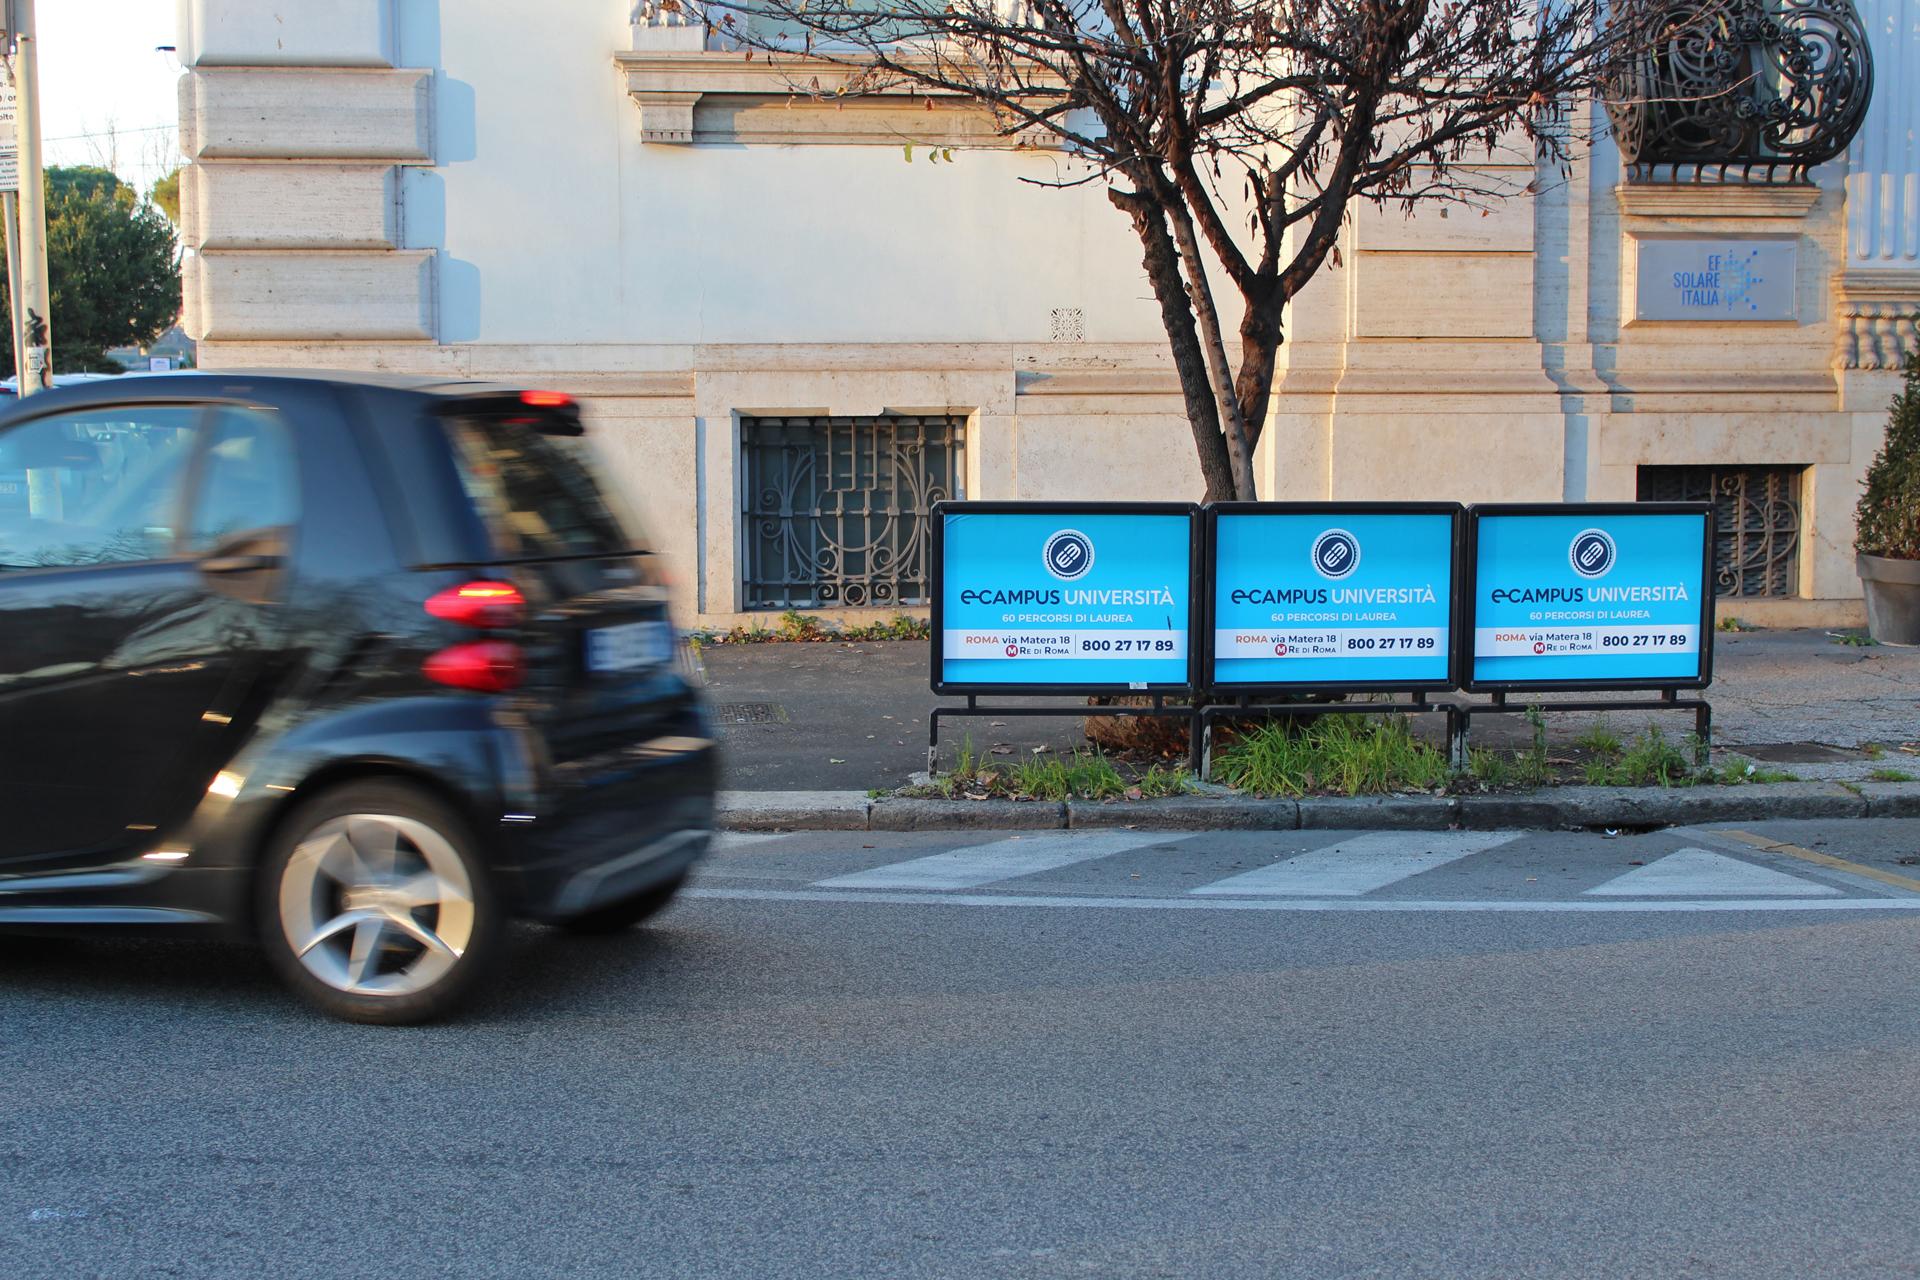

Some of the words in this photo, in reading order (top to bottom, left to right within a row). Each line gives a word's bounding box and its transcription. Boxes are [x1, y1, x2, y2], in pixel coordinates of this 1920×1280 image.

[1709, 256, 1721, 271] EF
[1674, 273, 1720, 288] SOLARE
[1682, 290, 1718, 305] ITALIA
[1065, 586, 1174, 605] UNIVERSITÀ
[1332, 584, 1435, 603] UNIVERSITÀ
[1588, 583, 1688, 602] UNIVERSITÀ
[1002, 614, 1015, 622] 60
[1019, 614, 1072, 622] PERCORSI
[1076, 614, 1087, 622] DI
[1090, 614, 1133, 622] LAUREA
[1272, 614, 1284, 622] 60
[1287, 613, 1338, 621] PERCORSI
[1342, 613, 1352, 621] DI
[1356, 613, 1396, 621] LAUREA
[1530, 612, 1542, 620] 60
[1545, 611, 1594, 620] PERCORSI
[1598, 611, 1607, 619] DI
[1610, 610, 1649, 619] LAUREA
[966, 636, 999, 644] ROMA
[1003, 636, 1017, 644] via
[1020, 636, 1056, 644] Matera
[1060, 636, 1070, 644] 18
[1288, 635, 1323, 643] Matera
[1529, 633, 1543, 641] via
[1546, 633, 1579, 641] Matera
[1603, 636, 1629, 647] 800
[1633, 636, 1648, 646] 27
[1652, 636, 1665, 645] 17
[1670, 635, 1686, 645] 89
[1082, 640, 1110, 651] 800
[1115, 640, 1132, 650] 27
[1136, 641, 1150, 650] 17
[1155, 640, 1173, 651] 89
[1348, 639, 1374, 649] 800
[1379, 638, 1395, 649] 27
[1400, 638, 1413, 648] 17
[1417, 638, 1434, 648] 89
